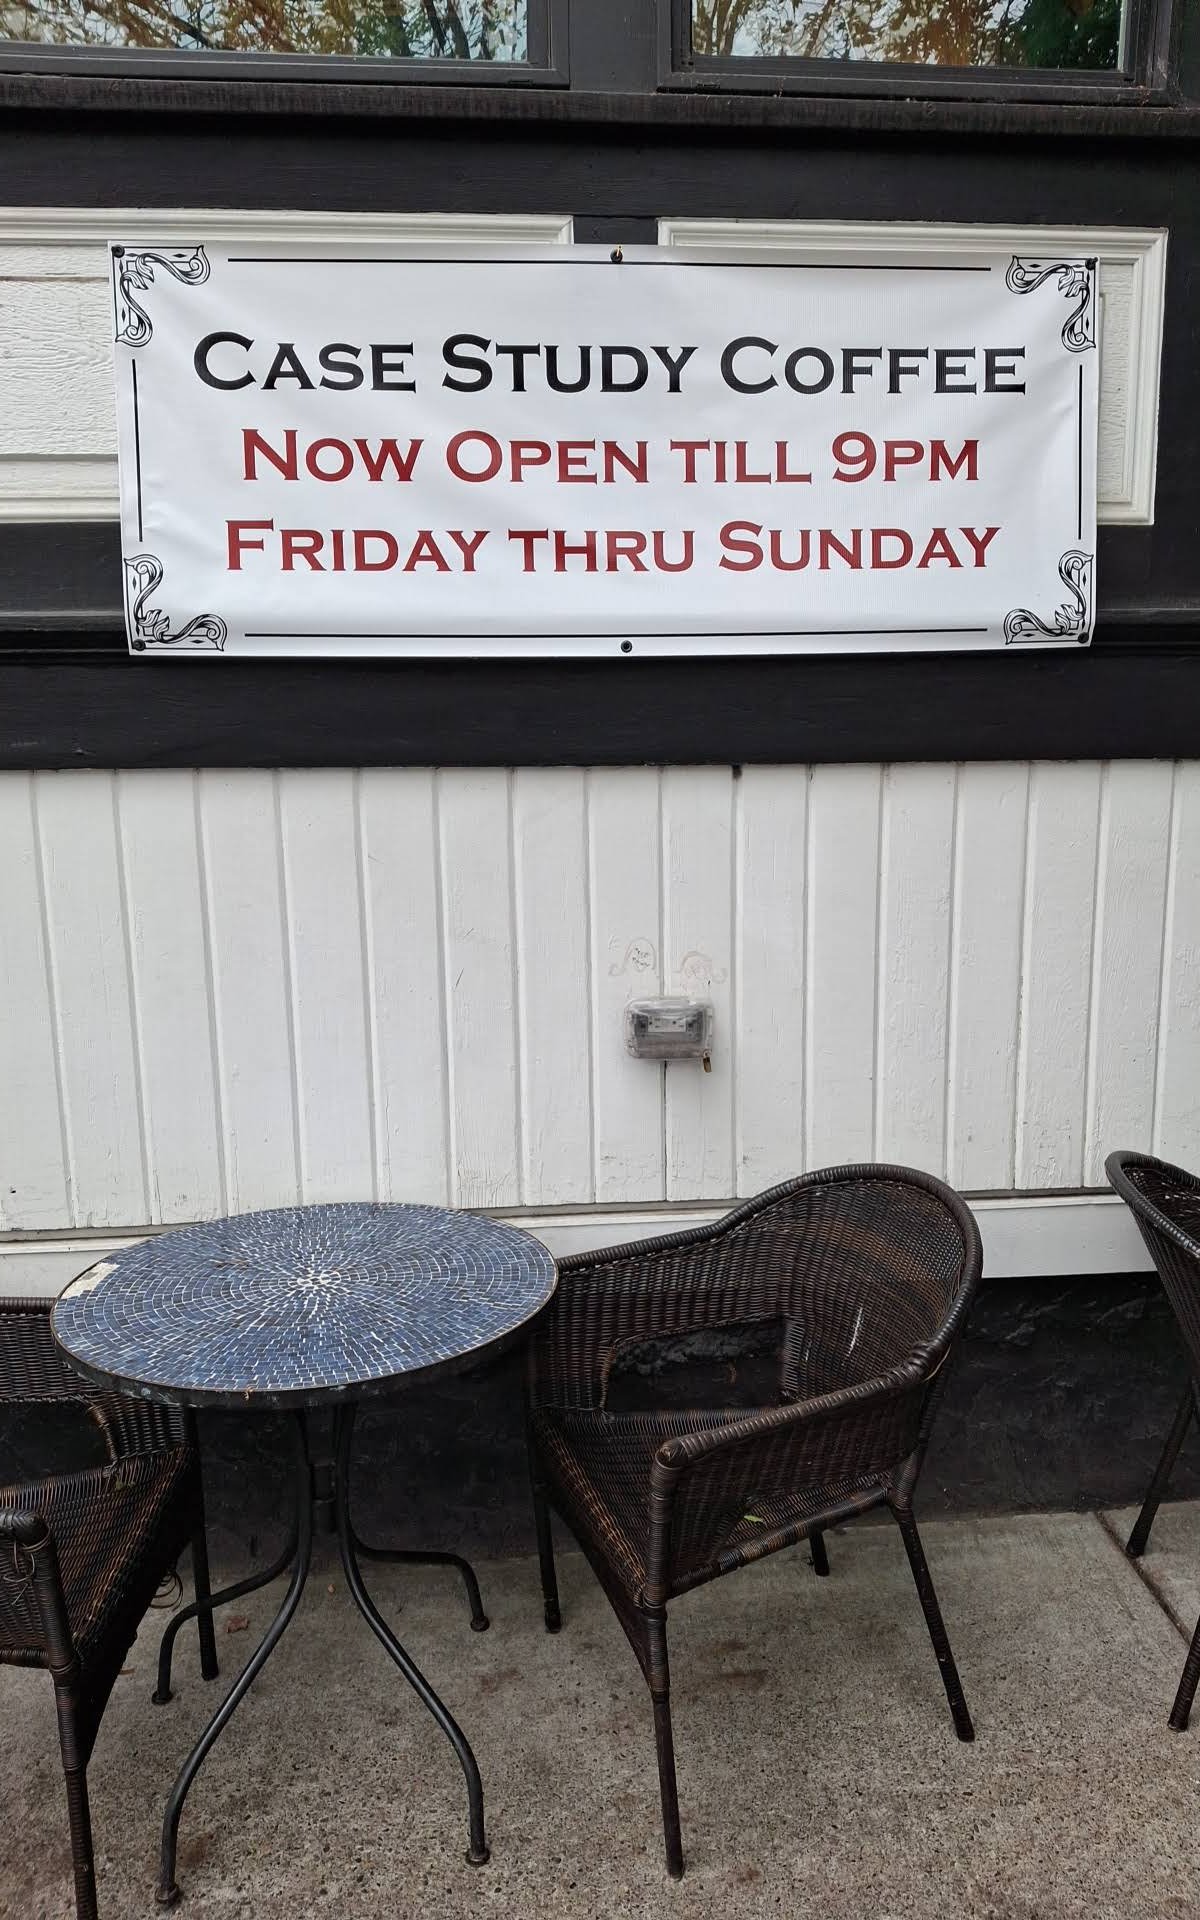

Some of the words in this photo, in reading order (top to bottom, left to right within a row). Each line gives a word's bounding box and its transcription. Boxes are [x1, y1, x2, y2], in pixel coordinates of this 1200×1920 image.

[193, 331, 417, 394] CASE
[441, 333, 699, 394] STUDY
[720, 336, 1027, 396] COFFEE
[241, 428, 425, 483] NOW
[446, 430, 649, 485] OPEN
[670, 439, 812, 485] TILL
[832, 431, 980, 483] 9PM
[226, 518, 490, 572] FRIDAY
[508, 529, 695, 572] THRU
[719, 520, 1001, 572] SUNDAY
